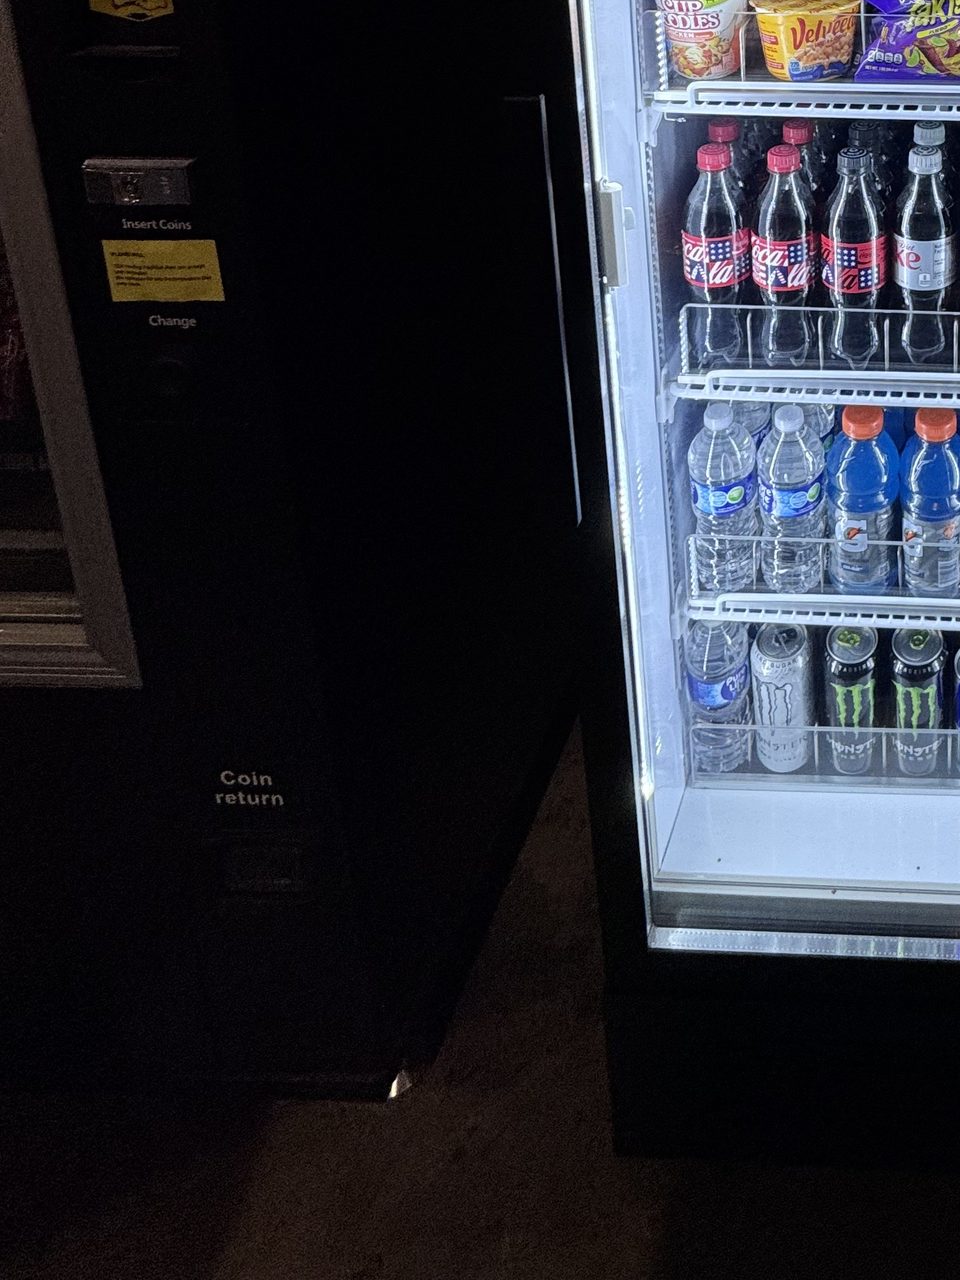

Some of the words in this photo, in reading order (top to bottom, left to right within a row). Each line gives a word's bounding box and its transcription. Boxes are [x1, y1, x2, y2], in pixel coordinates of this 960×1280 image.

[121, 218, 158, 230] Insert
[159, 219, 192, 230] Coins
[148, 314, 198, 329] Change
[219, 769, 273, 786] Coin
[215, 791, 285, 807] return
